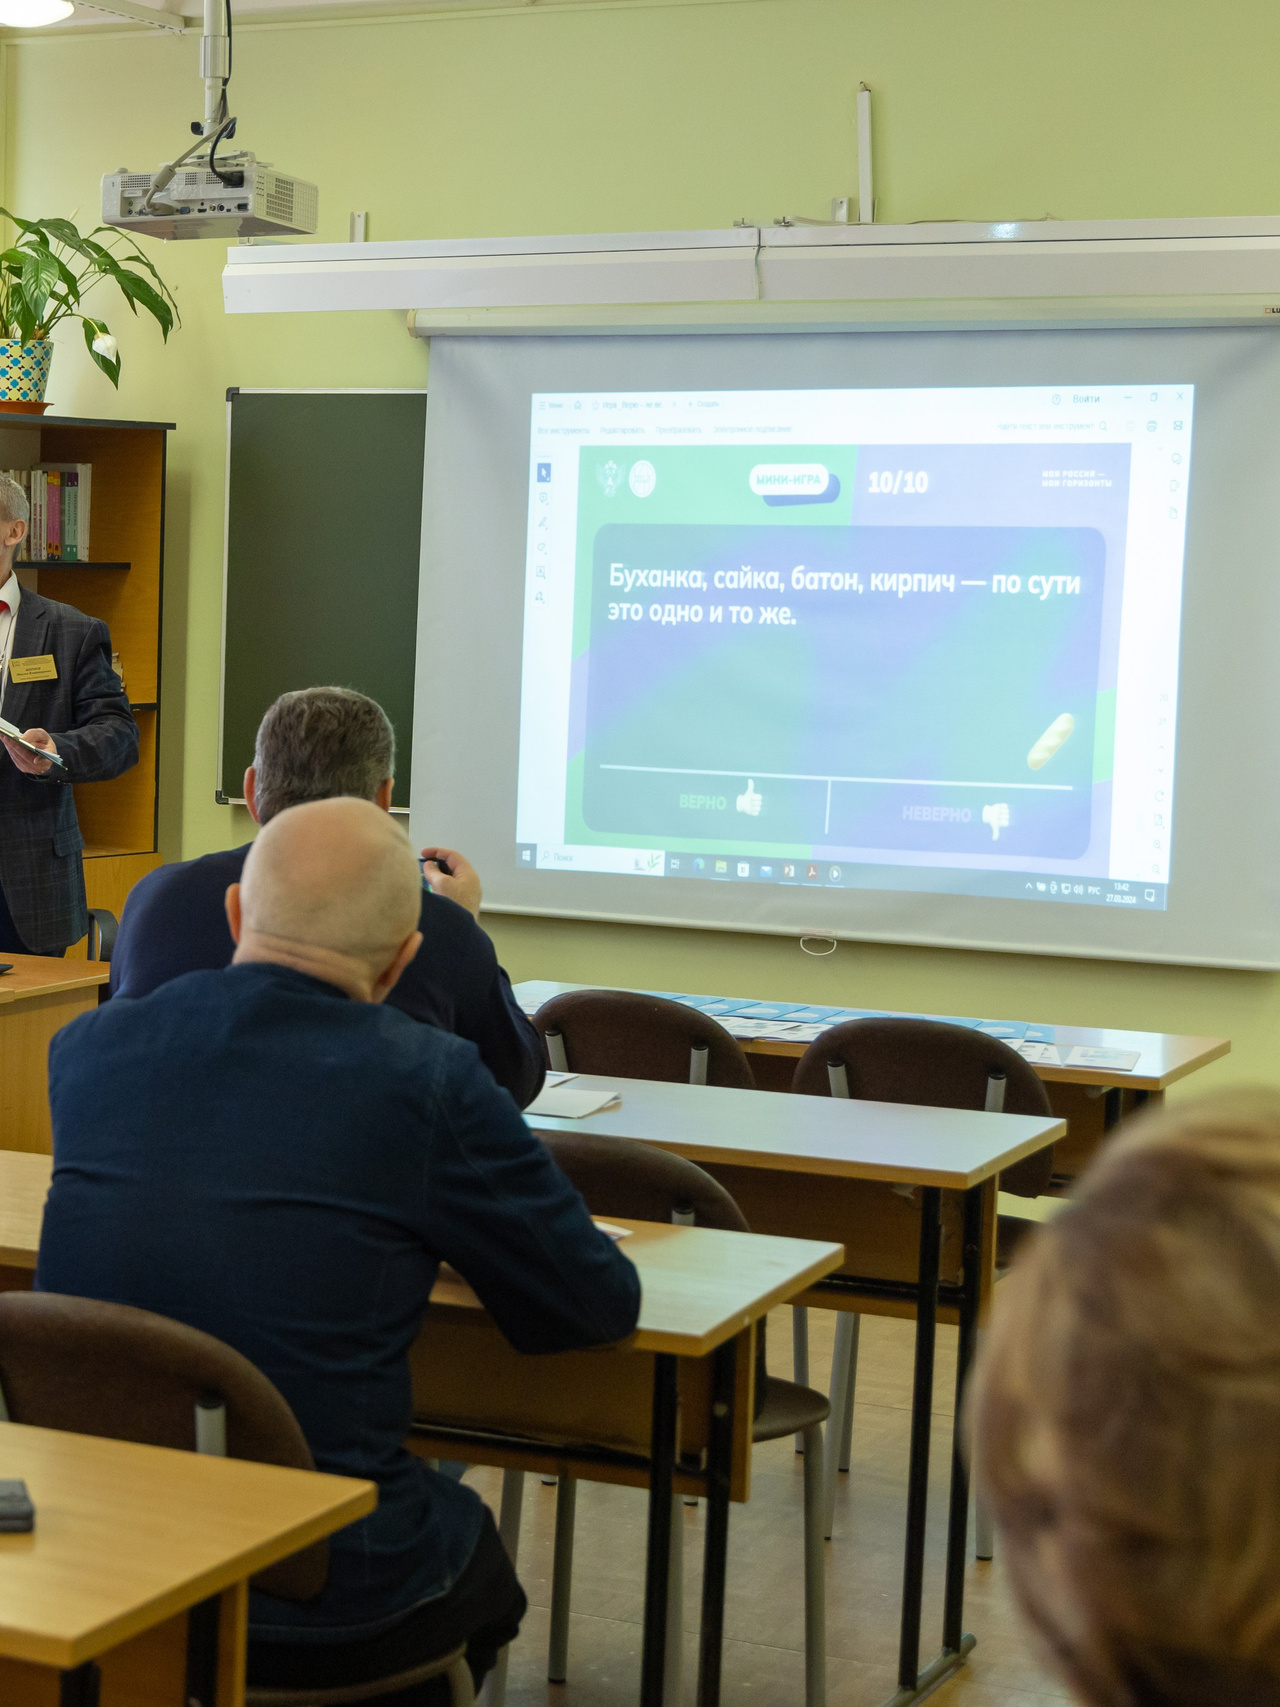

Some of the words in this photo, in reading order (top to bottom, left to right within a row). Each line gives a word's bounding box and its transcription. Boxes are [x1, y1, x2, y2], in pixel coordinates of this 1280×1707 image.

[1072, 394, 1100, 404] Войти
[756, 473, 822, 486] МИНИ-ИГРА
[1062, 470, 1096, 478] РОССИЯ
[867, 470, 929, 495] 10/10
[1062, 479, 1113, 487] ГОРИЗОНТЫ
[609, 562, 708, 591] Буханка,
[713, 566, 786, 592] сайка,
[790, 565, 864, 593] батон,
[870, 573, 956, 598] кирпич
[992, 574, 1020, 594] по
[1027, 574, 1081, 600] сути
[607, 602, 643, 622] это
[648, 602, 704, 626] одно
[709, 604, 723, 623] и
[728, 604, 754, 624] то
[759, 604, 798, 625] же.
[679, 793, 727, 811] ВЕРНО
[902, 805, 972, 823] НЕВЕРНО
[553, 852, 574, 862] Поиск
[1087, 886, 1101, 895] РУС
[1106, 893, 1137, 904] 27.03.2024
